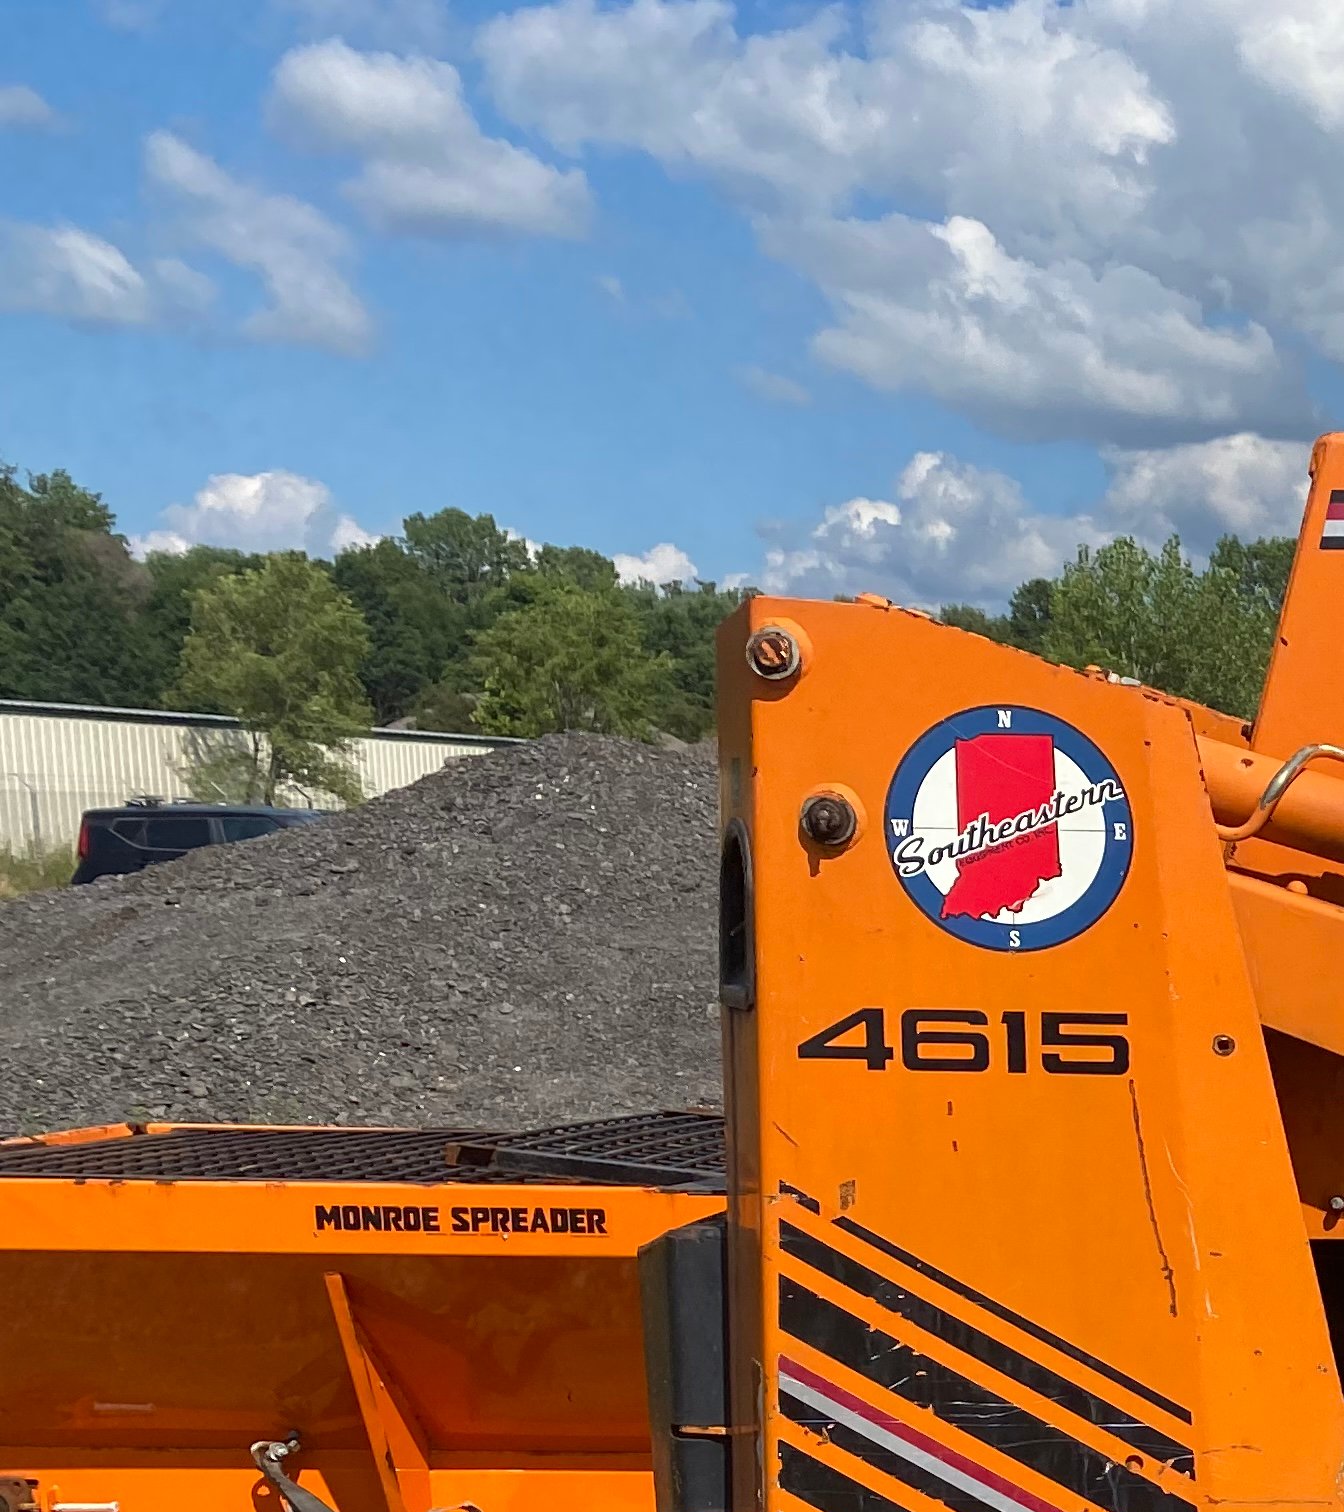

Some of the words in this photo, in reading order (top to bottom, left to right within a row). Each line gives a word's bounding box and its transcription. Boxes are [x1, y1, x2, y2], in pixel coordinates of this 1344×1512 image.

[997, 710, 1012, 729] N
[890, 818, 910, 838] W
[894, 778, 1125, 876] Southeastern
[1113, 822, 1127, 841] E
[1008, 928, 1020, 948] S
[797, 1007, 1130, 1075] 4615
[314, 1205, 441, 1233] MONROE
[450, 1206, 607, 1234] SPREADER
